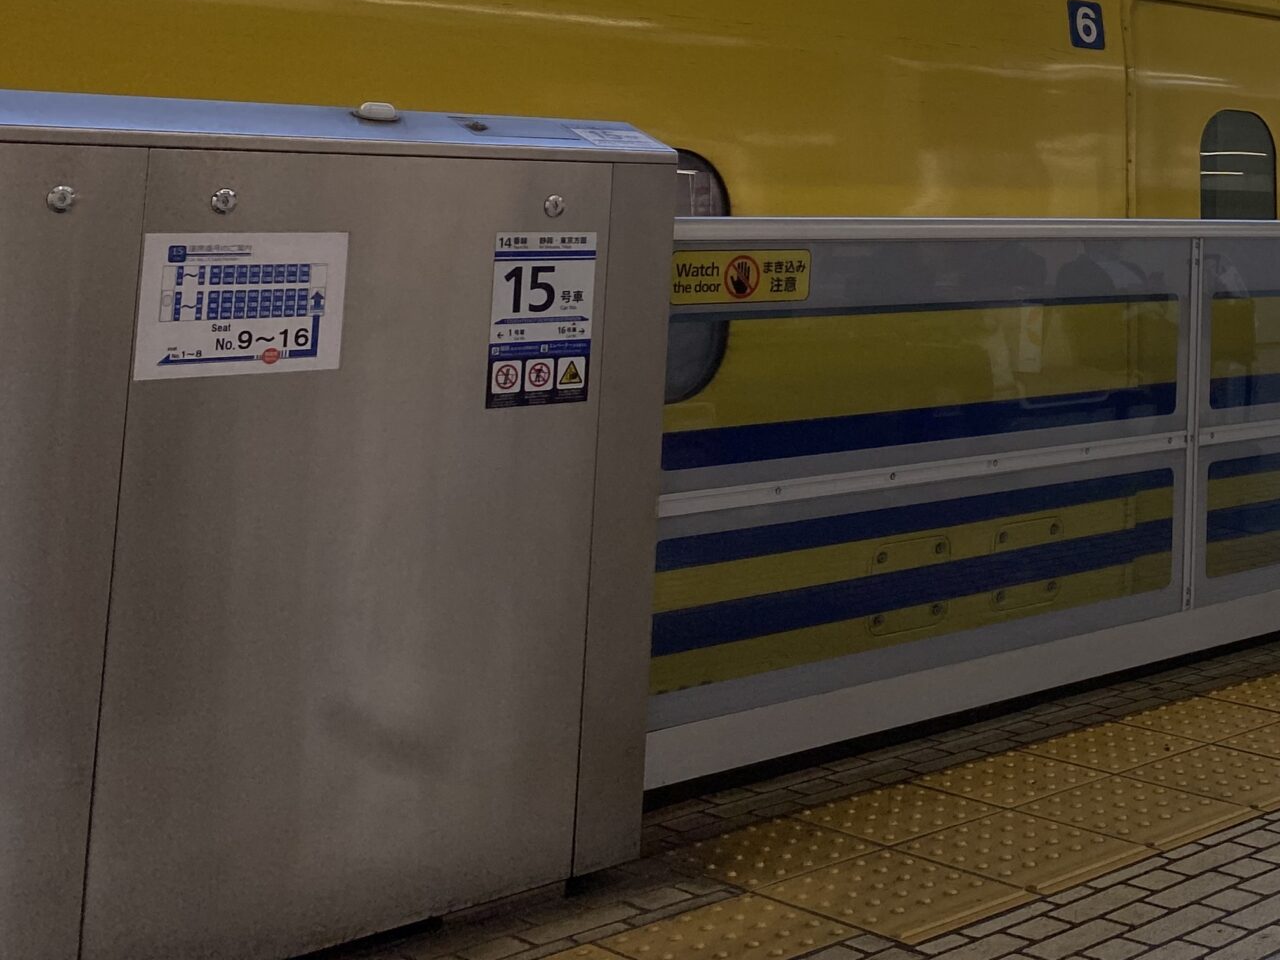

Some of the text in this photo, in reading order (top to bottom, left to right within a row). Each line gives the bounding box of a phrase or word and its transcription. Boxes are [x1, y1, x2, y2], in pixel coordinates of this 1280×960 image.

[1076, 6, 1097, 44] 6
[499, 237, 512, 248] 14
[676, 262, 720, 278] Watch
[763, 260, 807, 274] まき込み
[504, 266, 556, 313] 15
[673, 281, 722, 294] the door
[770, 277, 797, 293] 注意
[211, 324, 231, 332] Seat
